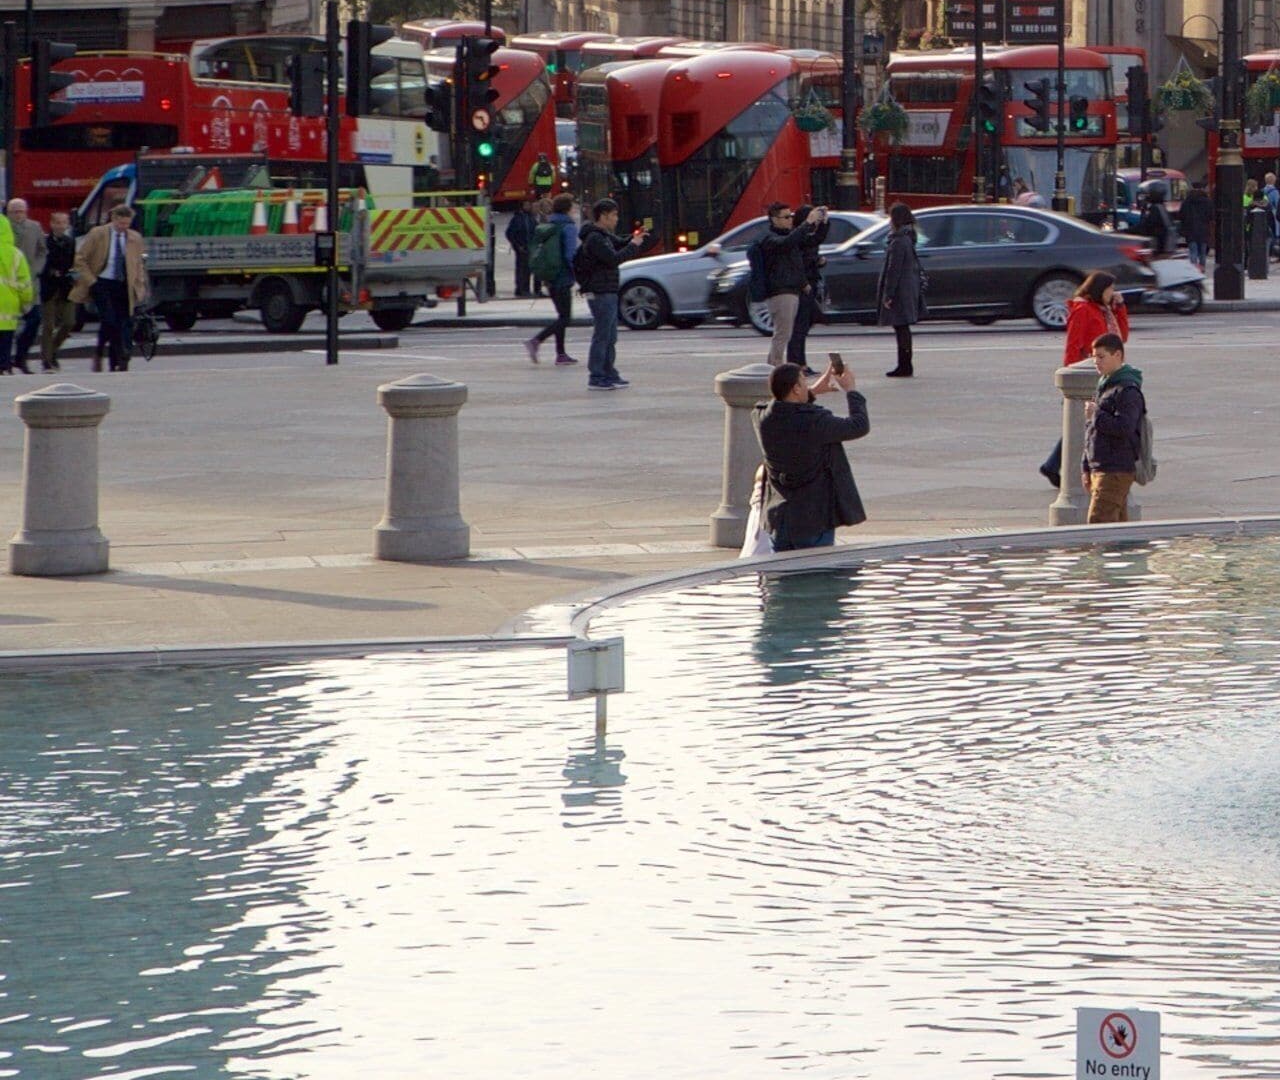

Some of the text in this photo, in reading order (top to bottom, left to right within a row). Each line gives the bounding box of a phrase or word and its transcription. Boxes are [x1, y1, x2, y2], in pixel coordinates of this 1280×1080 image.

[158, 242, 235, 261] Hire-A-Lite
[1086, 1059, 1151, 1080] No entry
